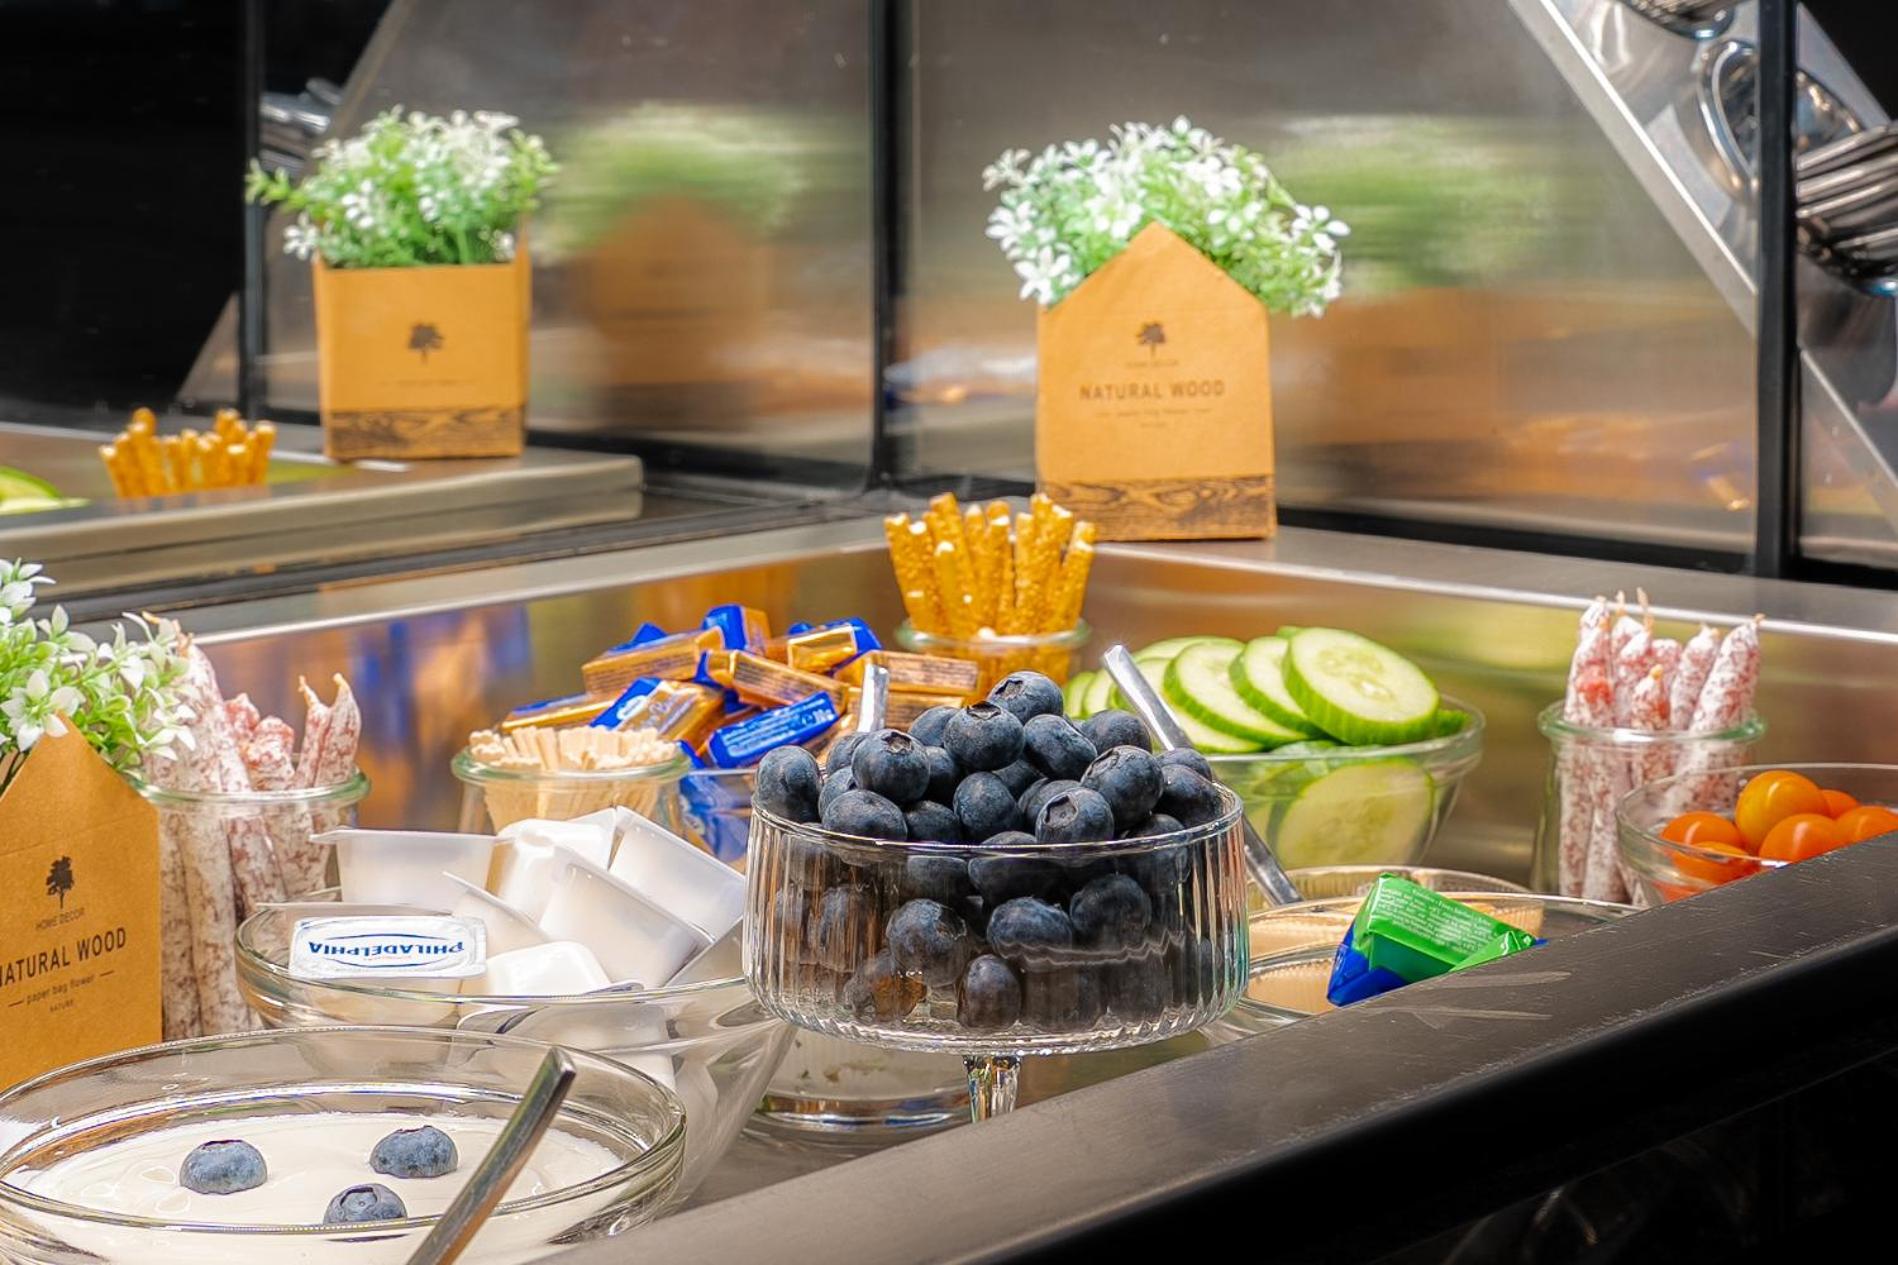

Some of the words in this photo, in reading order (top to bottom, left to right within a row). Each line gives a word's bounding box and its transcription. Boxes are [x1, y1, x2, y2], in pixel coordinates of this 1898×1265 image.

[1079, 383, 1163, 401] NATURAL
[1170, 379, 1226, 398] WOOD
[0, 946, 70, 988] ATURAL
[77, 927, 126, 962] WOOD
[308, 941, 464, 956] PHILADELPHIA
[27, 989, 51, 1004] paper
[52, 983, 67, 995] bag
